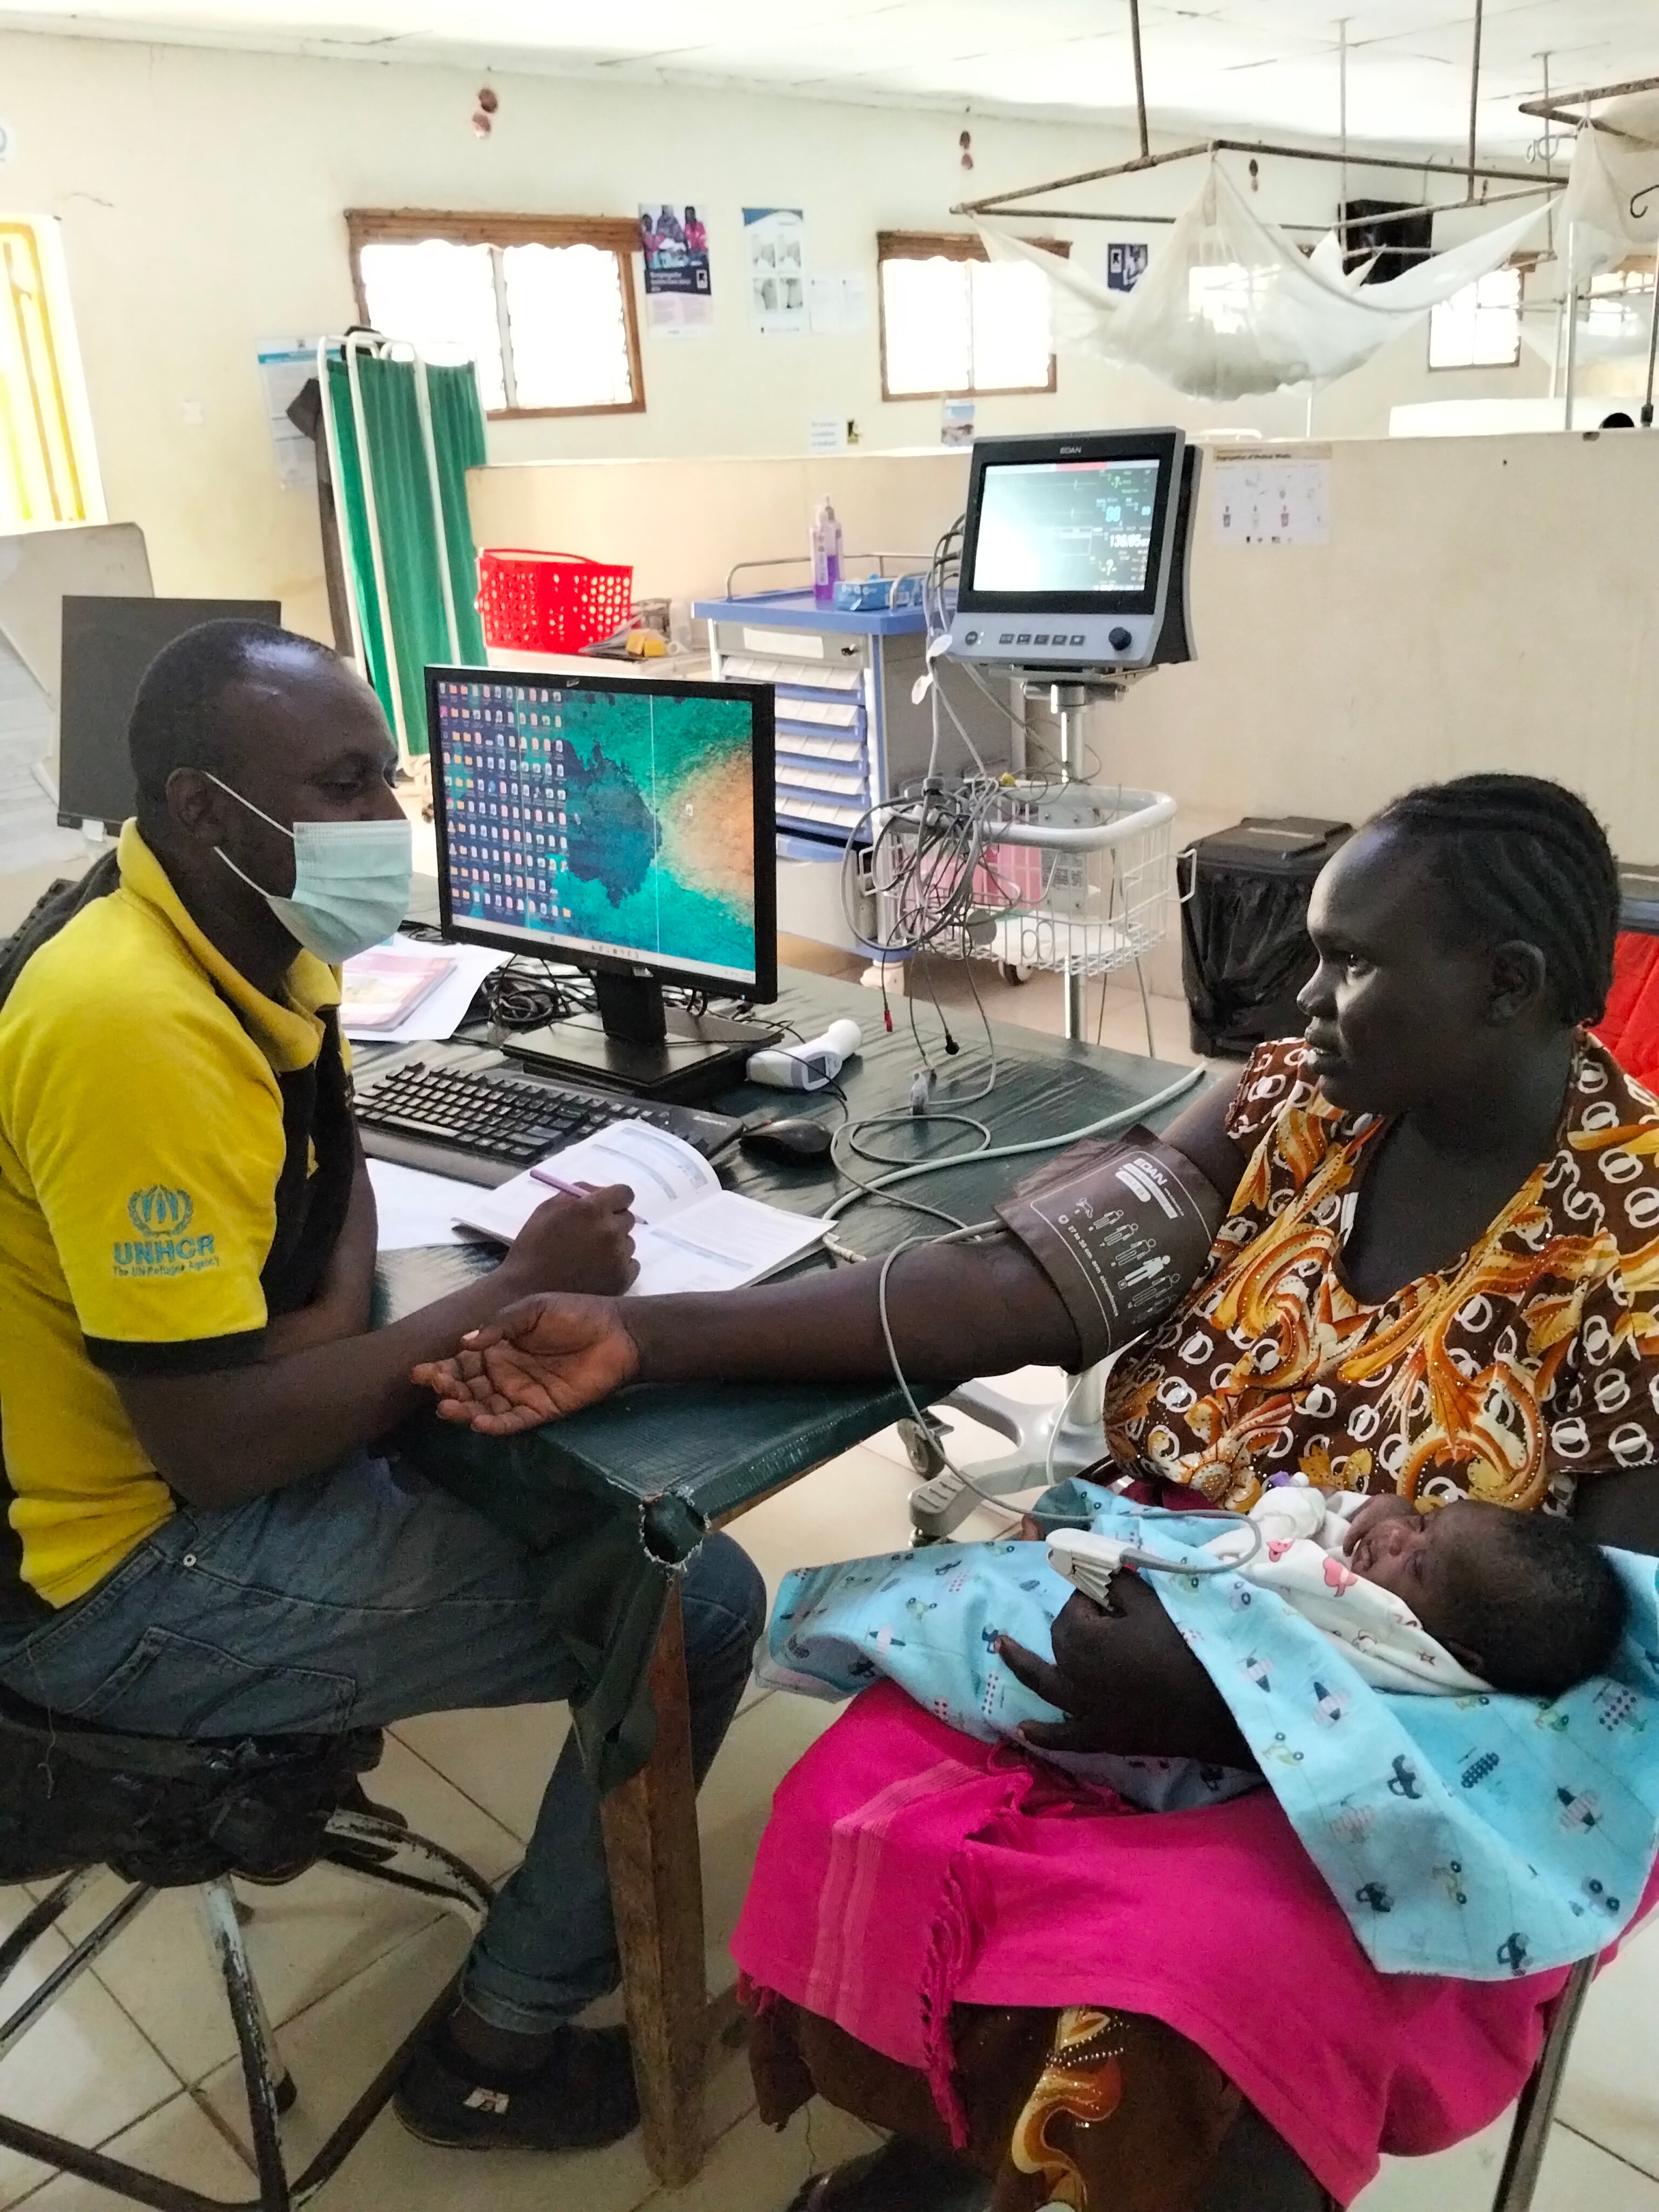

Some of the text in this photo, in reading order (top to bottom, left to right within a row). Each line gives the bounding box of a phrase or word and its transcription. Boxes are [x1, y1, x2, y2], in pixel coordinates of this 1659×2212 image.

[1133, 1158, 1168, 1185] EDAN
[114, 1234, 214, 1264] UNHCR
[132, 1265, 146, 1277] UN
[1091, 1260, 1101, 1274] arm
